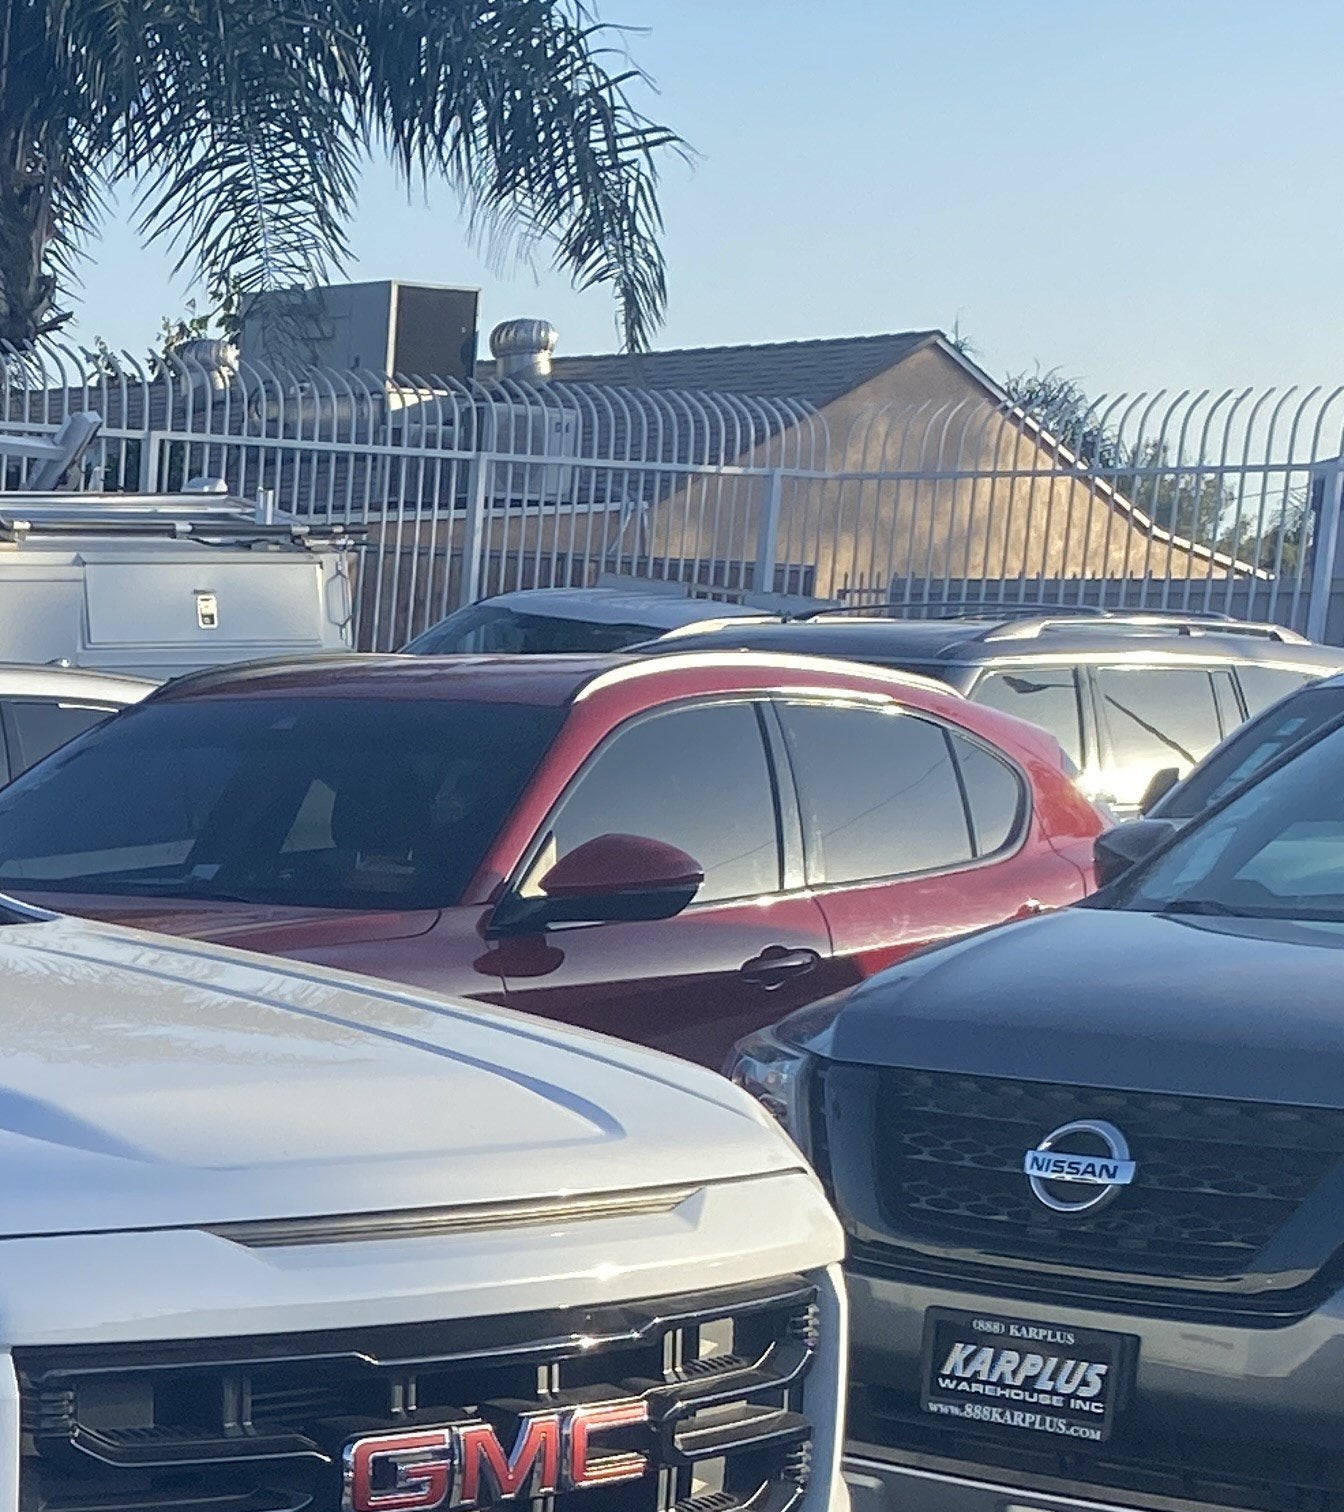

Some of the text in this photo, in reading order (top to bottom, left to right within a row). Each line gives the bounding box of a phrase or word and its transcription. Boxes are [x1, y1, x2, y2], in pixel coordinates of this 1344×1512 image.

[1030, 1155, 1119, 1179] NISSAN
[971, 1318, 1075, 1345] (888) KARPLUS
[939, 1342, 1109, 1399] KARPLUS
[937, 1376, 1106, 1414] WAREHOUSE INC
